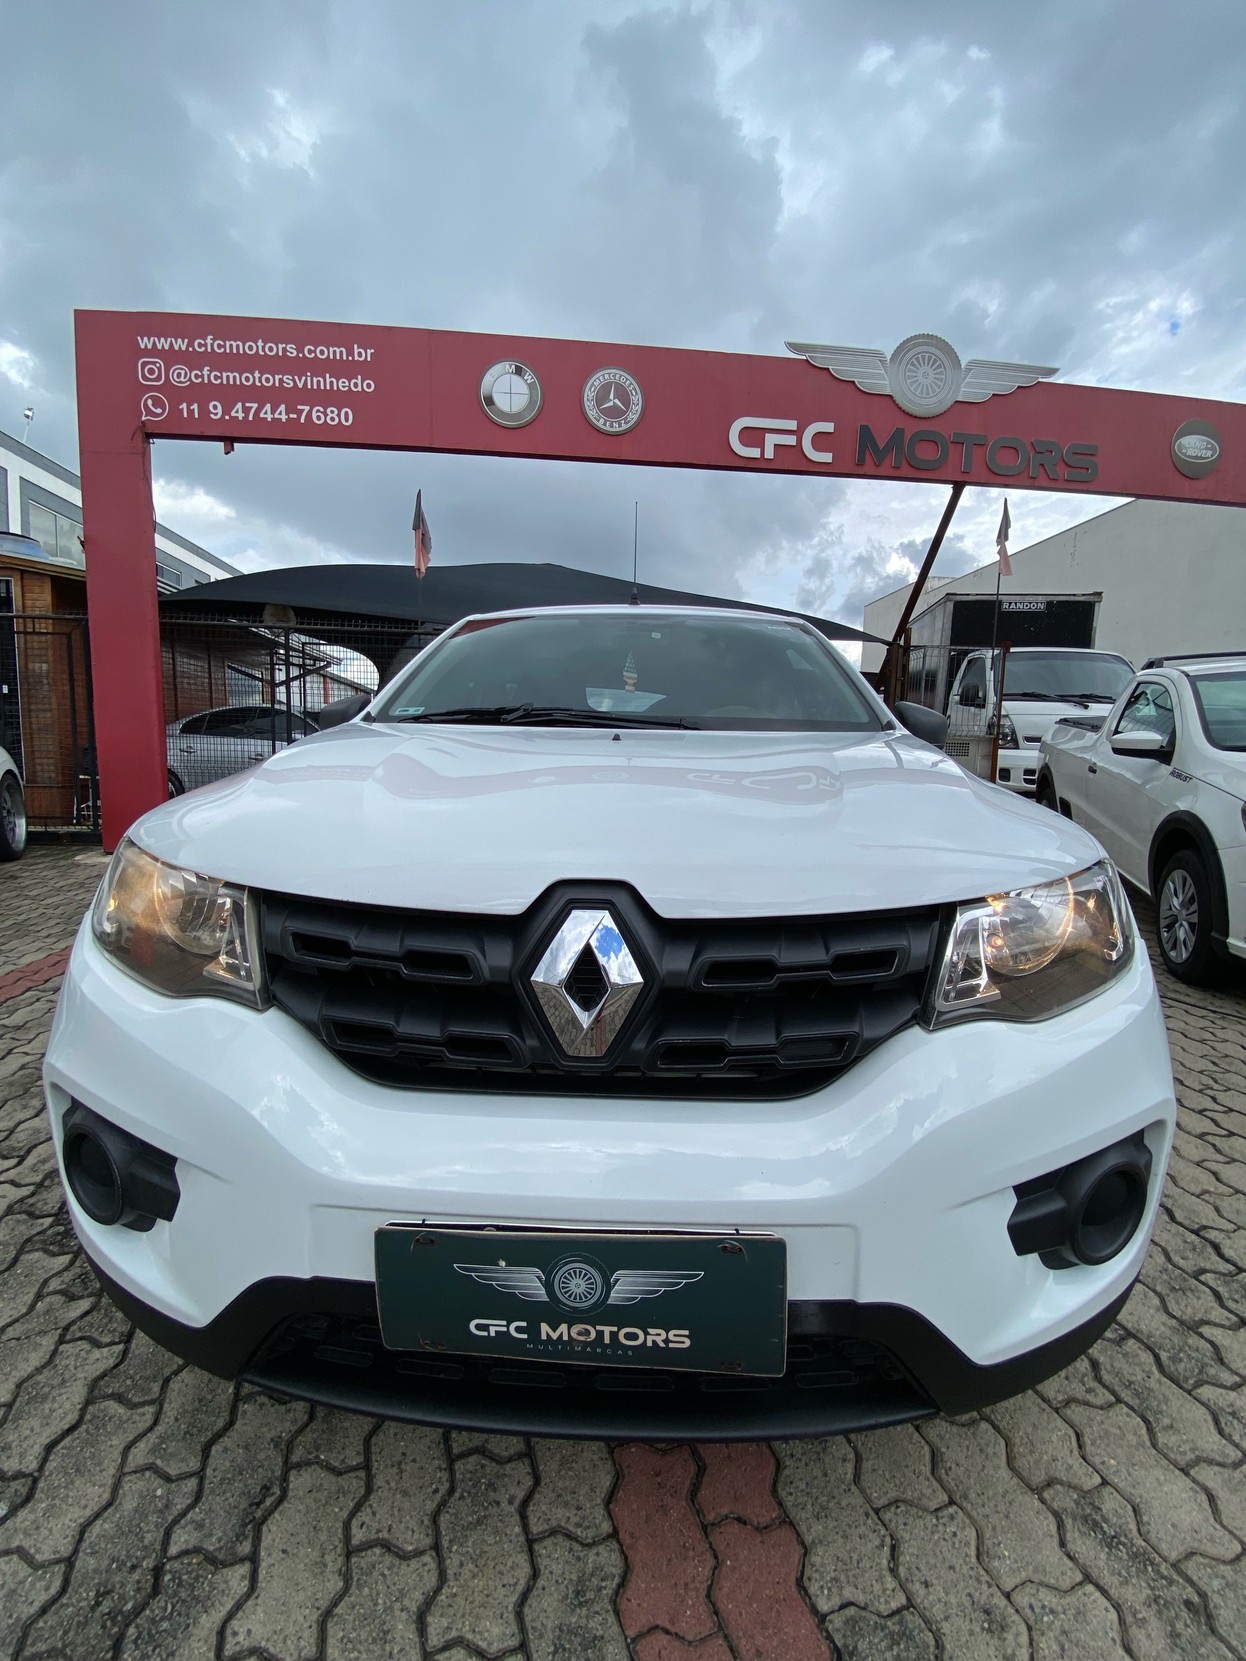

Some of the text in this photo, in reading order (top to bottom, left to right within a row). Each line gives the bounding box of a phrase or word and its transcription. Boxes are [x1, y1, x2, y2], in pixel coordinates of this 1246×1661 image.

[137, 335, 374, 362] www.cfcmotors.com.br
[169, 364, 375, 393] @cfcmotorsvinhedo
[593, 373, 635, 391] MERCEDES
[179, 401, 353, 427] 11 9.4744-7680
[599, 418, 627, 429] BENZ
[728, 416, 1099, 482] CFC MOTORS
[1002, 602, 1045, 610] RANDON
[1169, 769, 1193, 784] ROBUST
[469, 1318, 691, 1348] CFC MOTORS
[526, 1343, 633, 1356] MULTIMARCAS
